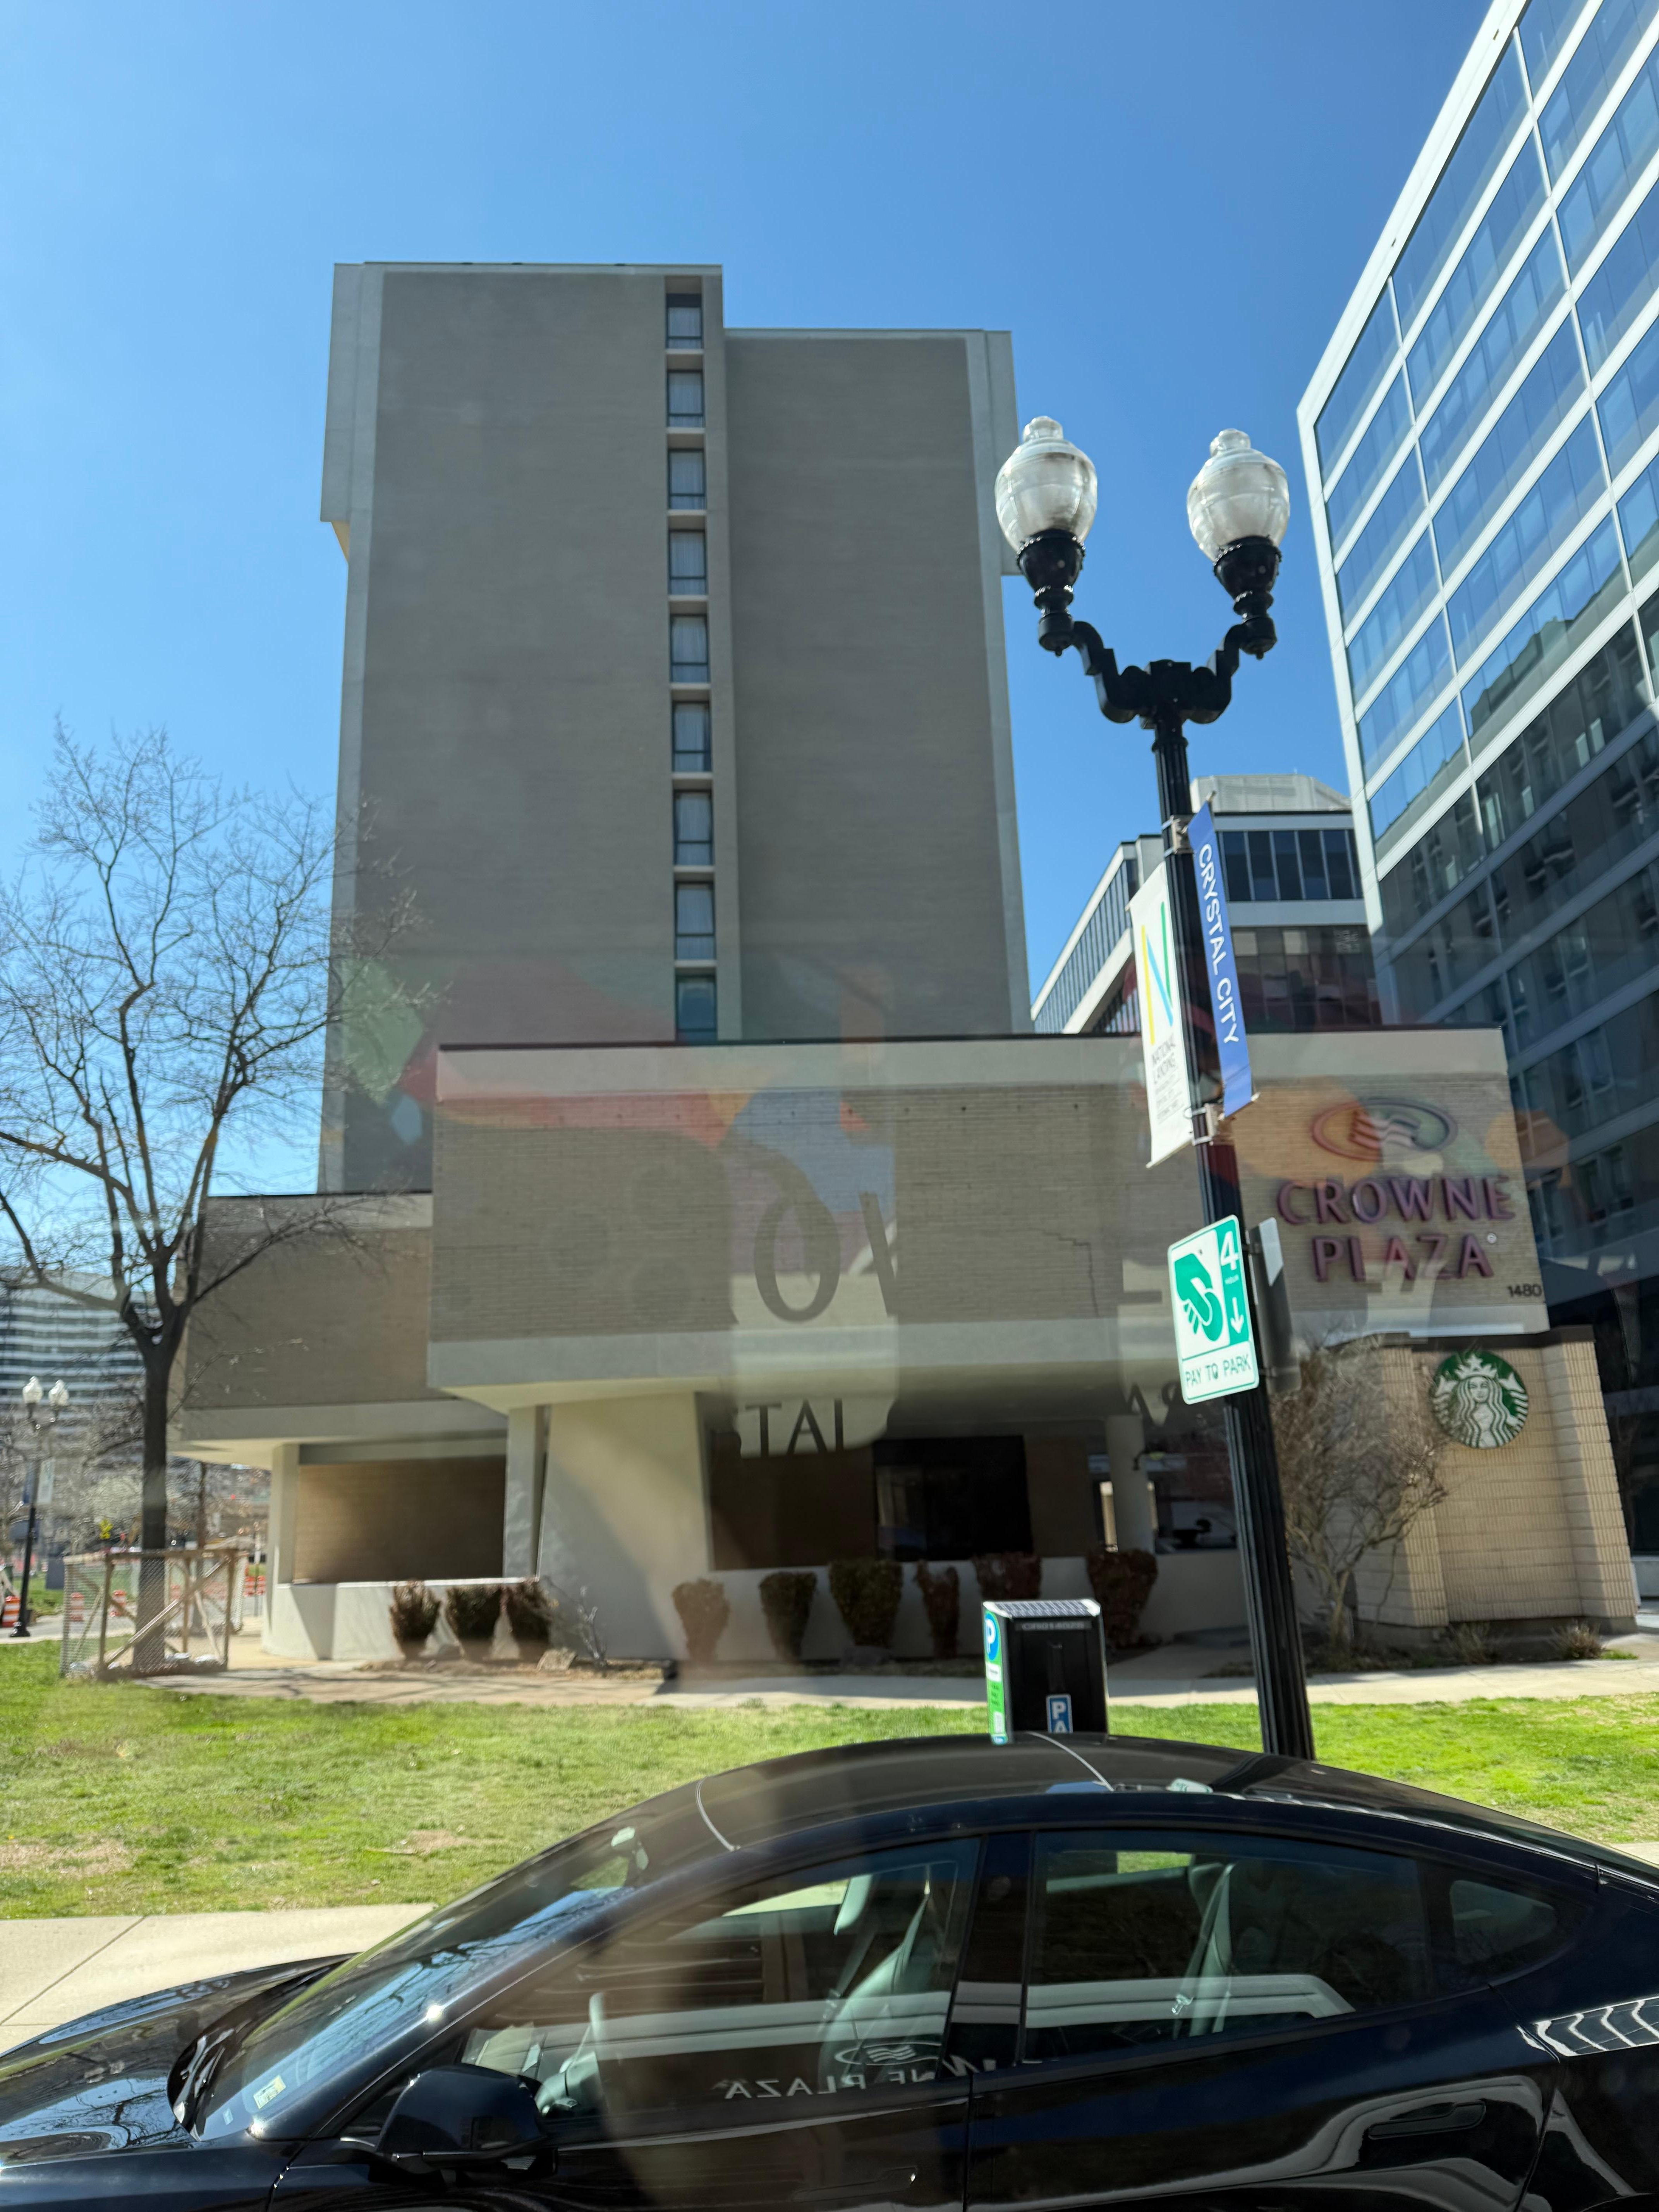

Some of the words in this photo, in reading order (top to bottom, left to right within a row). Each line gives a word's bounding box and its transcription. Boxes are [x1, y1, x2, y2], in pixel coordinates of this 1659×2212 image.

[1199, 843, 1227, 976] CRYSTAL
[1216, 977, 1239, 1044] CITY
[1277, 1175, 1515, 1225] CROWNE
[1220, 1230, 1239, 1271] 4
[1312, 1234, 1494, 1282] PLAZA
[1507, 1283, 1542, 1297] 1480
[1185, 1367, 1202, 1387] PAY
[1206, 1363, 1218, 1381] TO
[1223, 1354, 1251, 1377] PARK
